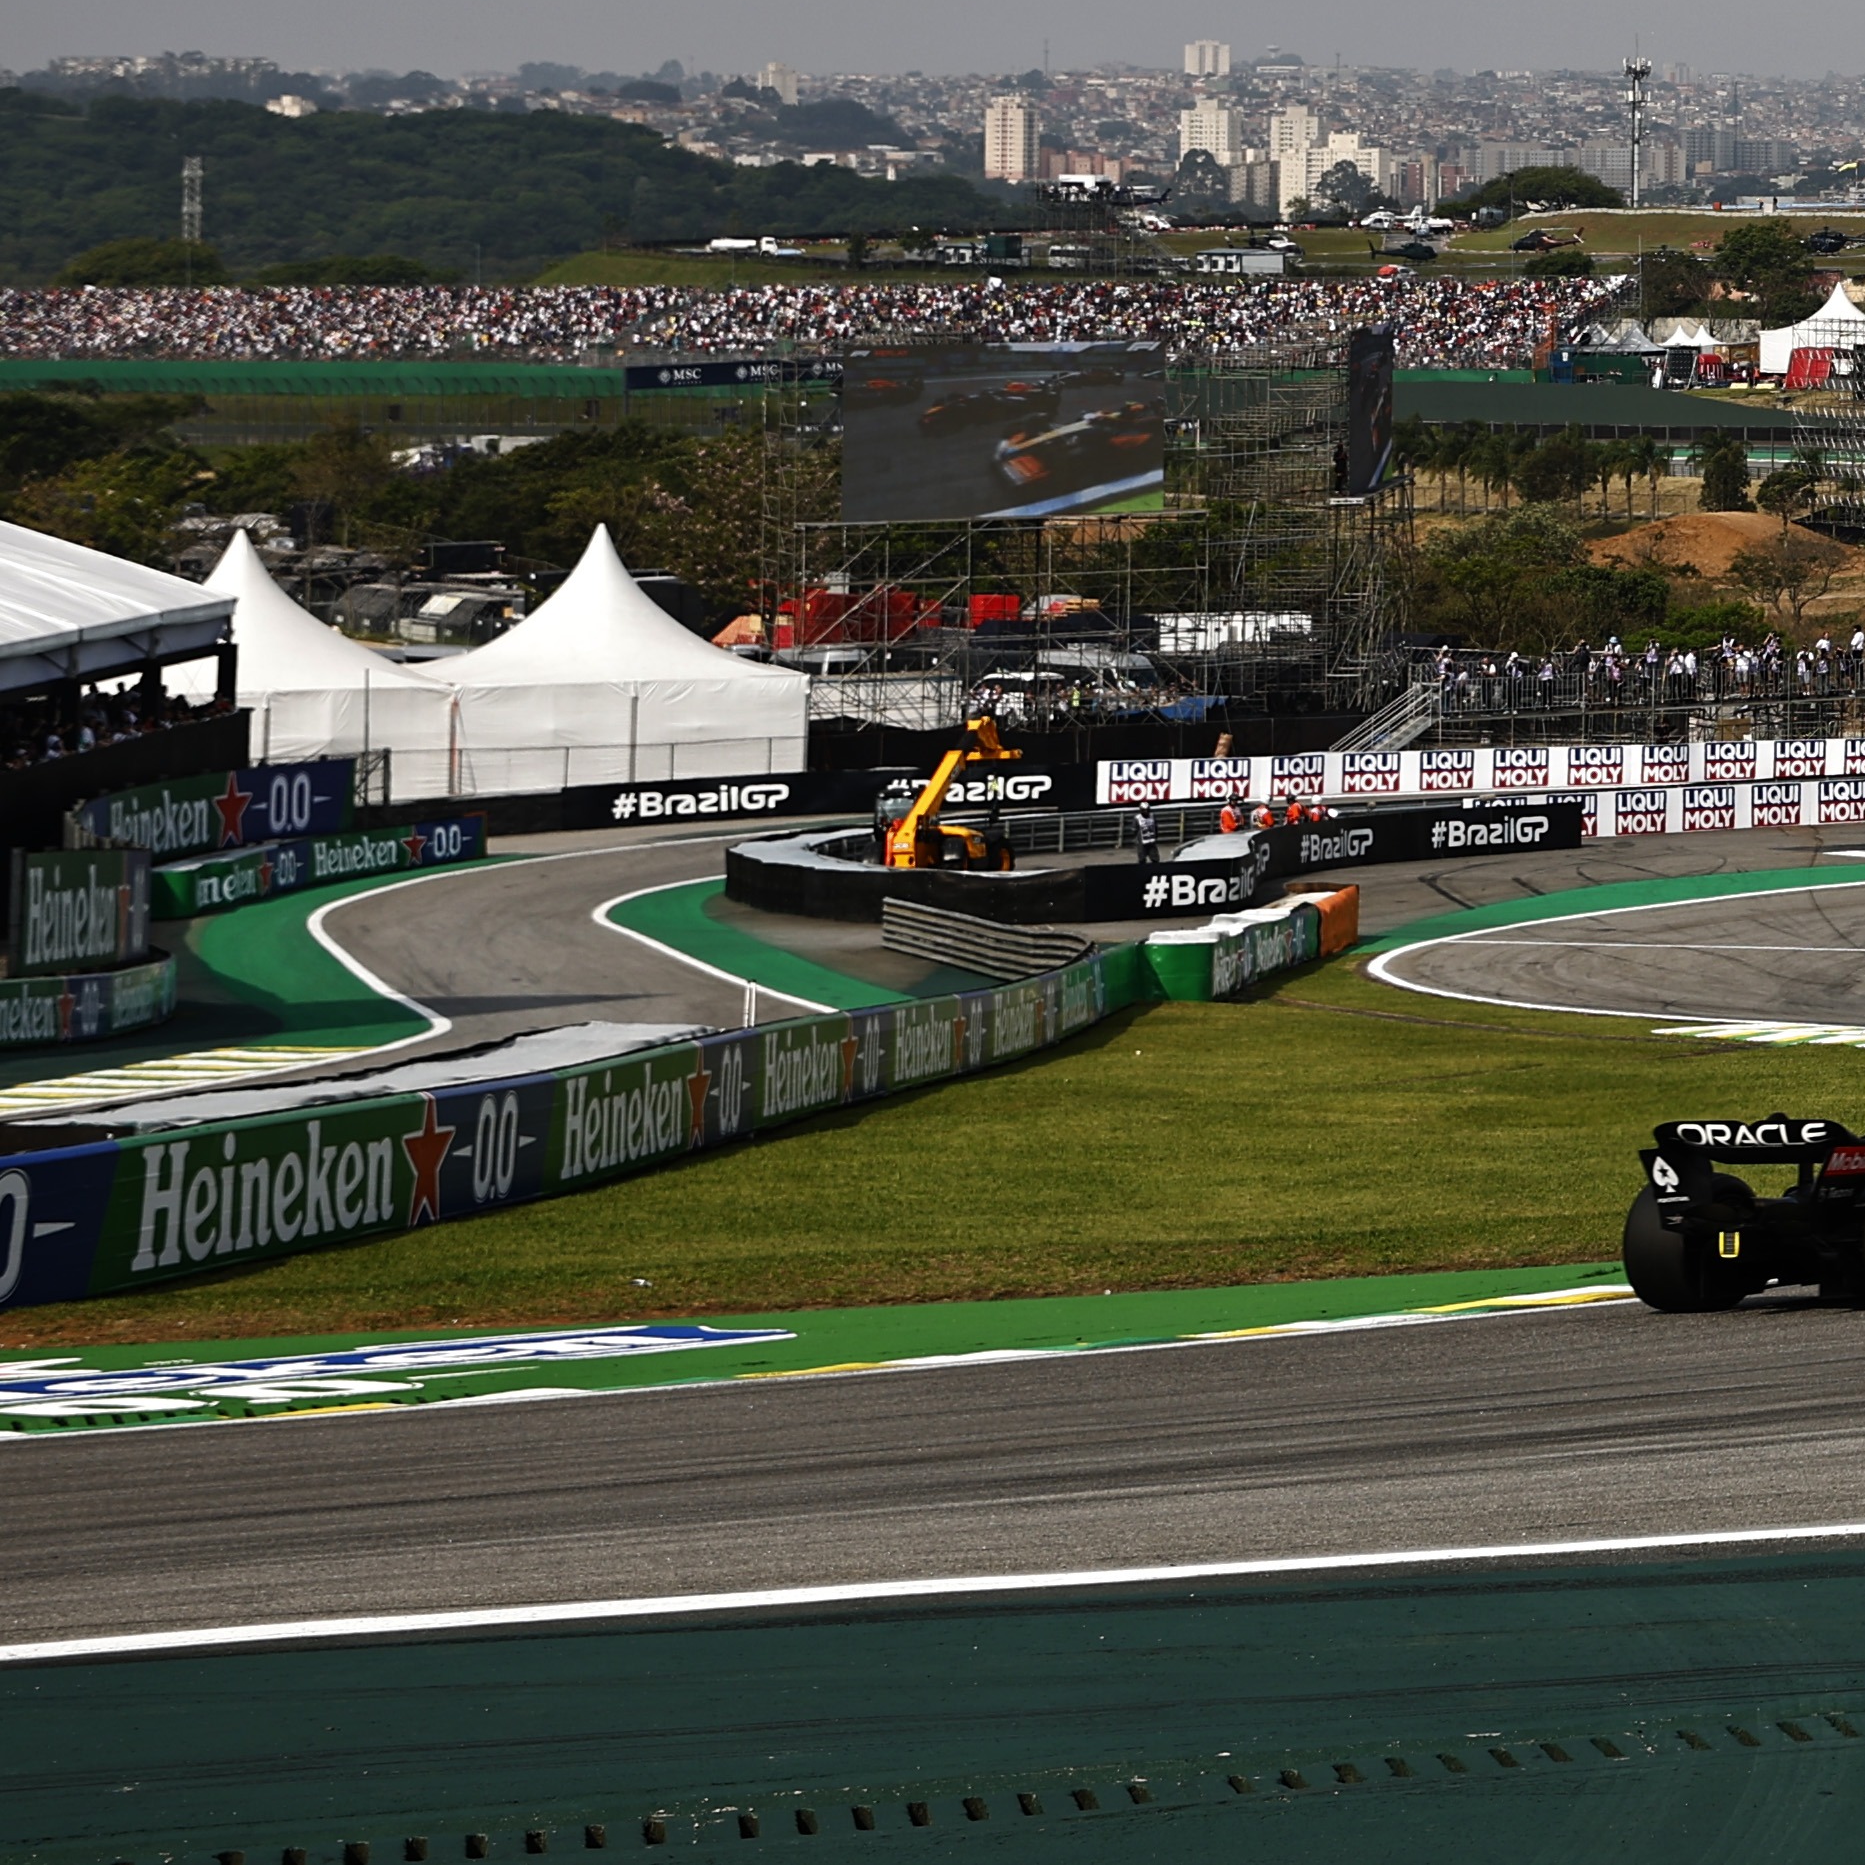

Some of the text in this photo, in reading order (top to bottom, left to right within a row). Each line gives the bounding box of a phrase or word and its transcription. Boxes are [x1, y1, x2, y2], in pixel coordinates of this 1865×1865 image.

[673, 367, 702, 381] MSC
[1423, 752, 1471, 769] LIQUI
[1496, 750, 1546, 767] LIQUI
[1571, 748, 1620, 765] LIQUI
[1707, 743, 1754, 760] LIQUI
[1112, 763, 1168, 781] LIQUI
[1496, 769, 1547, 786] MOLY
[1570, 767, 1622, 784] MOLY
[1707, 762, 1755, 778] MOLY
[1423, 771, 1472, 789] MOLY
[1112, 783, 1170, 801] MOLY
[1754, 785, 1798, 804] LIQUI
[1821, 782, 1865, 801] LIQUI
[269, 772, 311, 832] 0.0
[611, 783, 790, 820] #BrazilGP
[1618, 793, 1664, 812] LIQUI
[1618, 813, 1665, 833] MOLY
[1754, 806, 1799, 825] MOLY
[1431, 815, 1549, 849] #BrazilGP
[315, 824, 463, 877] Heineken 0.0
[1300, 828, 1374, 863] #BrazilGP
[894, 1005, 952, 1081] Heineken
[763, 1015, 881, 1117] Heineken 0.0
[561, 1043, 743, 1180] Heineken 0.0
[1676, 1122, 1828, 1147] ORACLE
[131, 1120, 394, 1272] Heineken
[473, 1089, 520, 1204] 0.0
